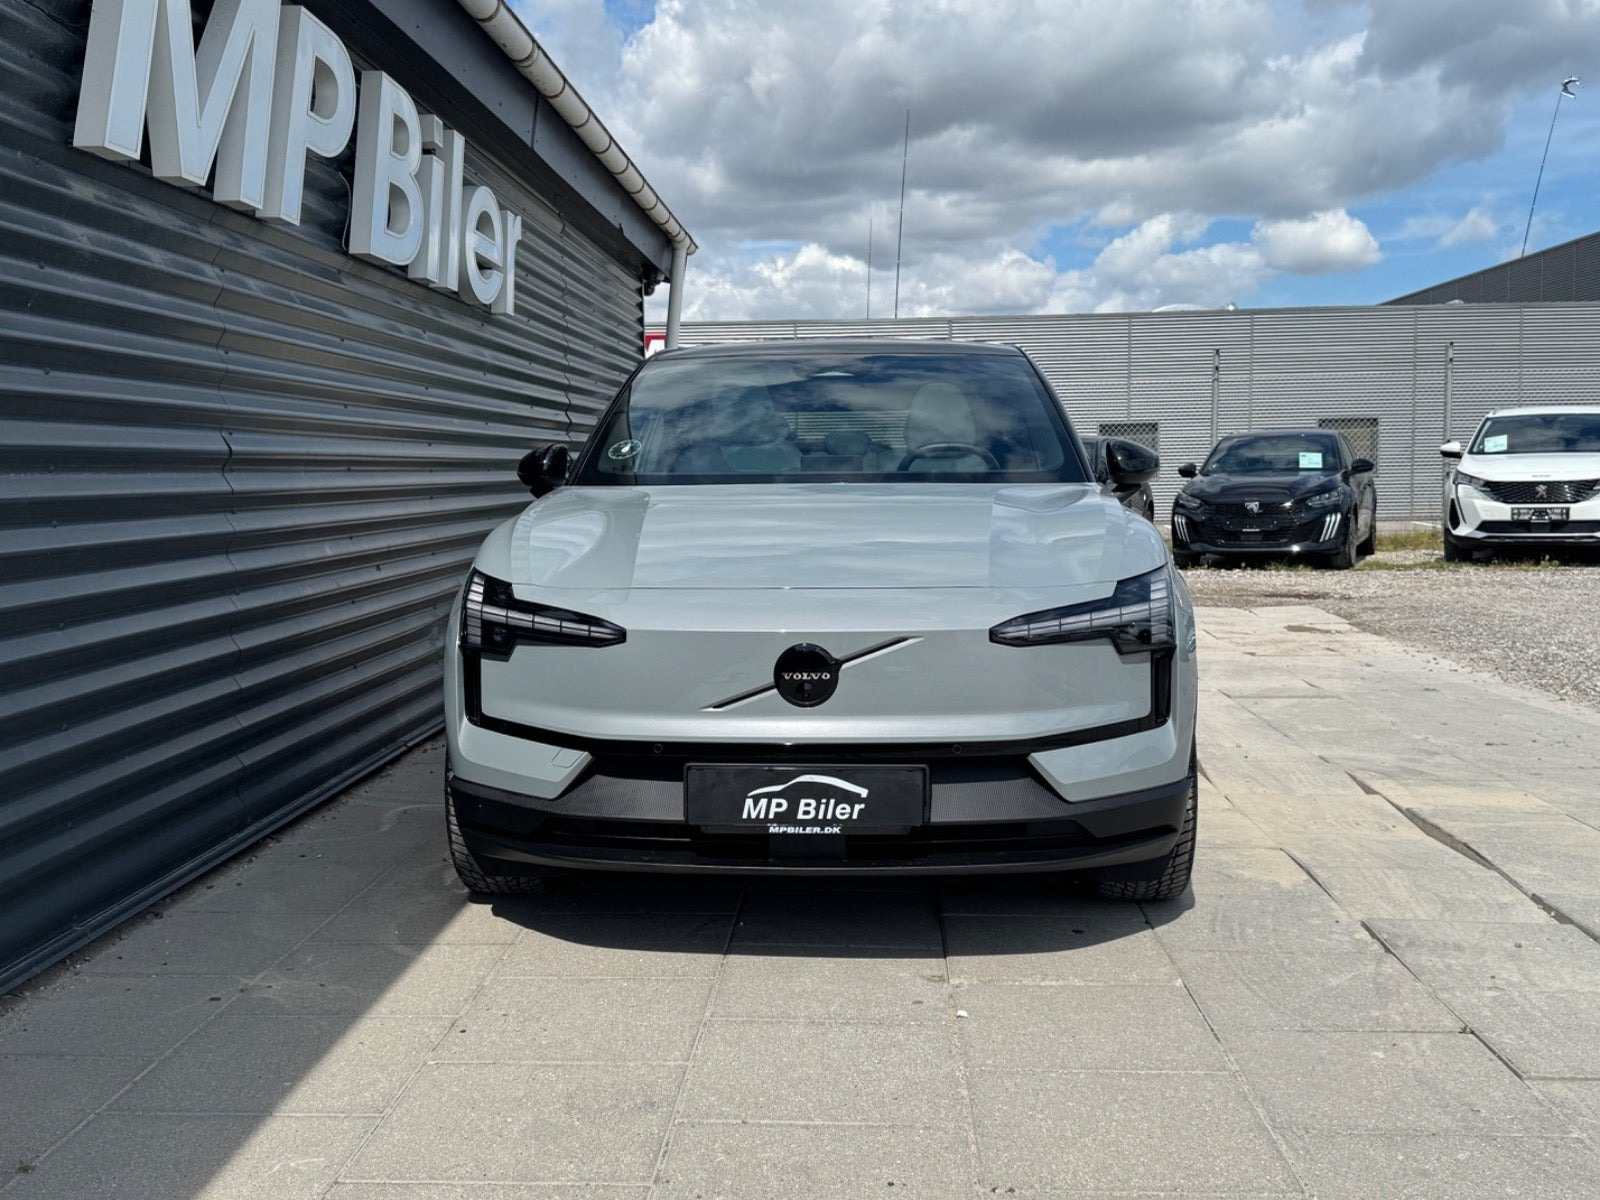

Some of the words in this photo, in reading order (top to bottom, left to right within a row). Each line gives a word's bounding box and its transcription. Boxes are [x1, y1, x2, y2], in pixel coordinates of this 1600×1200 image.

[782, 672, 831, 680] VOLVO
[742, 798, 788, 819] MP
[797, 798, 866, 820] Biler
[768, 826, 842, 834] MPBILER.DK
